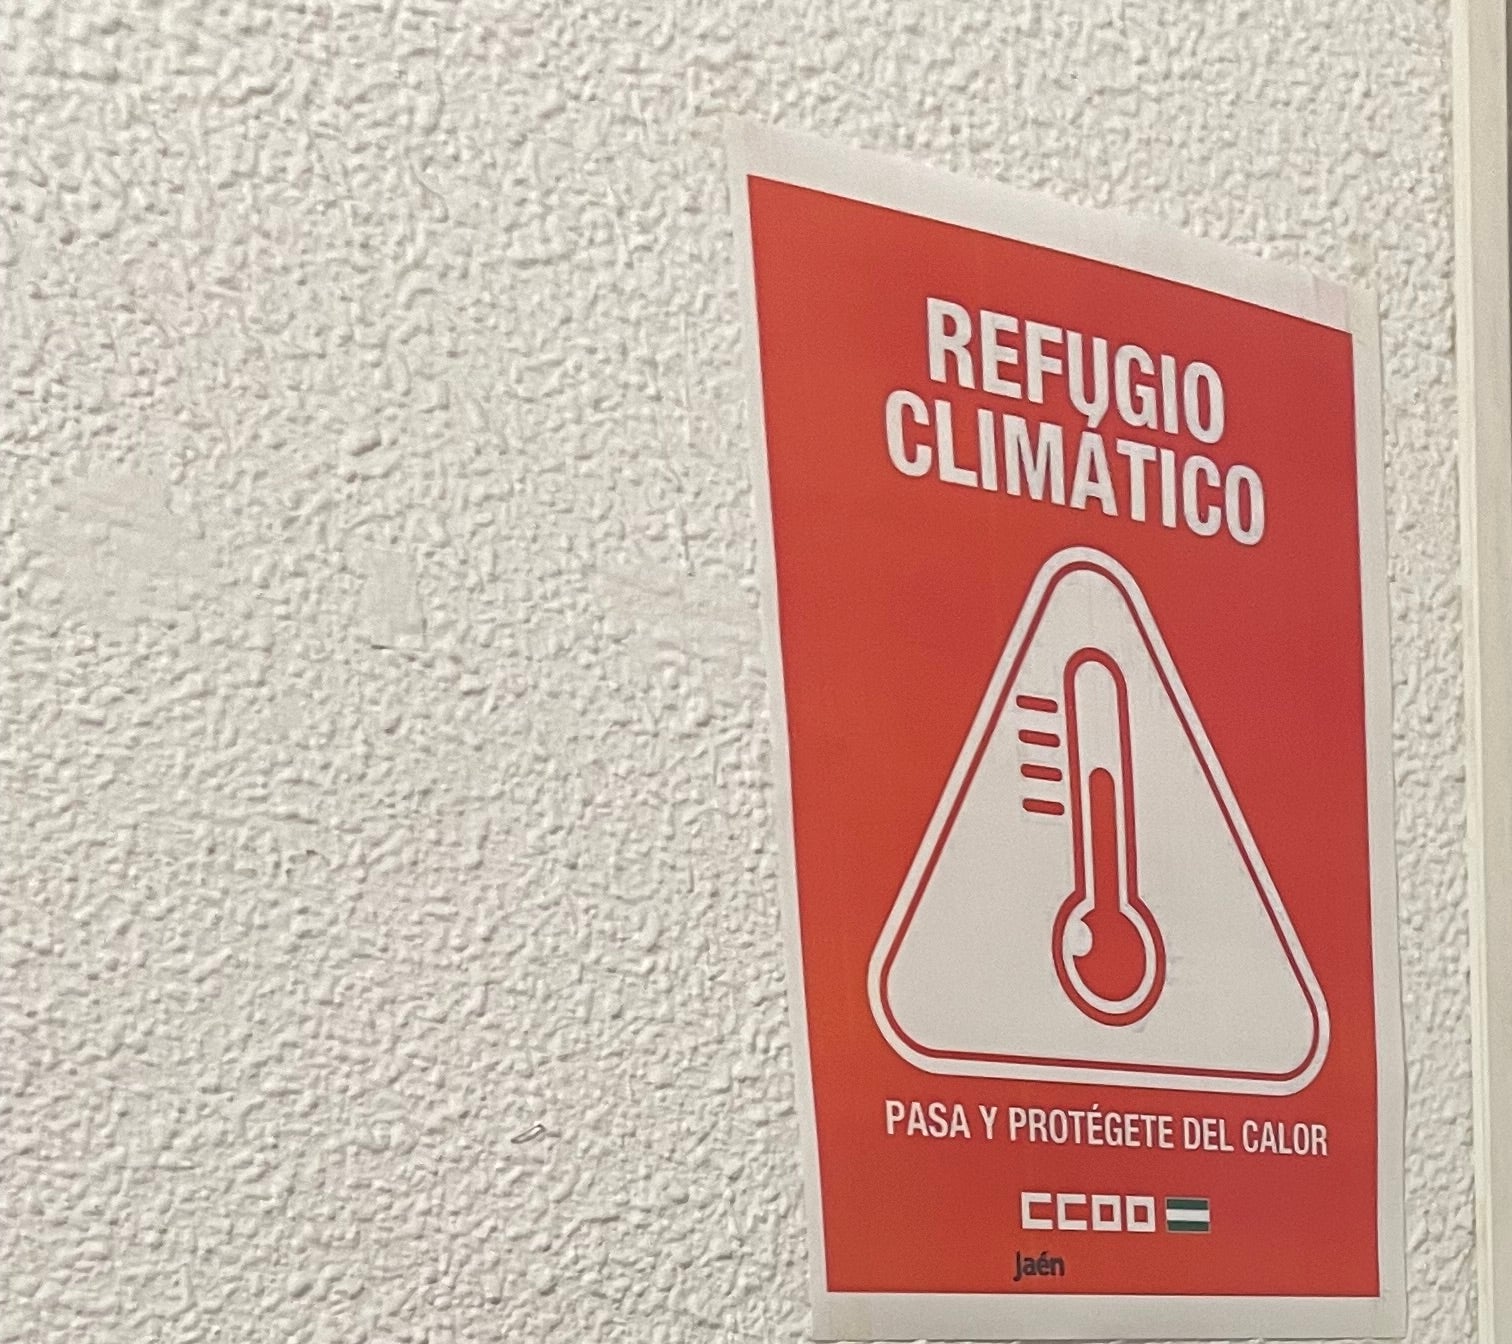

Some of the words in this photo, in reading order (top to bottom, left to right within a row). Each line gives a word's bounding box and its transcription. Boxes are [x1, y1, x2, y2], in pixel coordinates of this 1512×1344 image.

[926, 297, 1225, 444] REFUGIO
[885, 390, 1266, 546] CLIMÁTICO
[885, 1100, 971, 1139] PASA
[980, 1106, 997, 1140] Y
[1009, 1103, 1174, 1149] PROTÉGETE
[1184, 1116, 1234, 1152] DEL
[1243, 1120, 1328, 1157] CALOR
[1021, 1191, 1157, 1233] CCOO
[1014, 1251, 1065, 1282] Jaén
